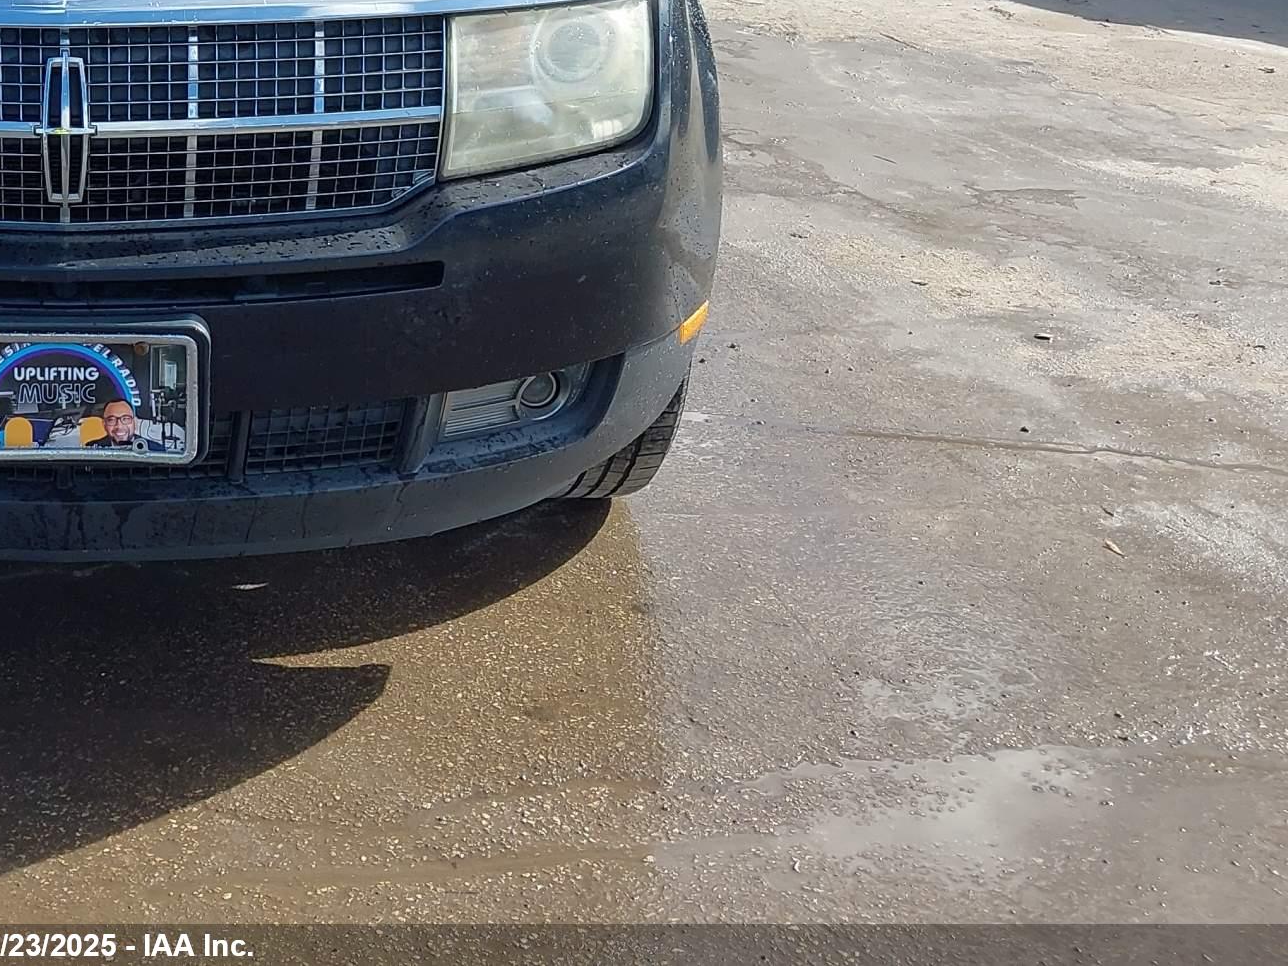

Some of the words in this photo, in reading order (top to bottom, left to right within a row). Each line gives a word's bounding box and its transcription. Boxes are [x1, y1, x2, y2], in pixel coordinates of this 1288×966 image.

[13, 366, 100, 381] UPLIFTING
[112, 357, 142, 407] RADIO
[18, 383, 96, 404] MUSIC
